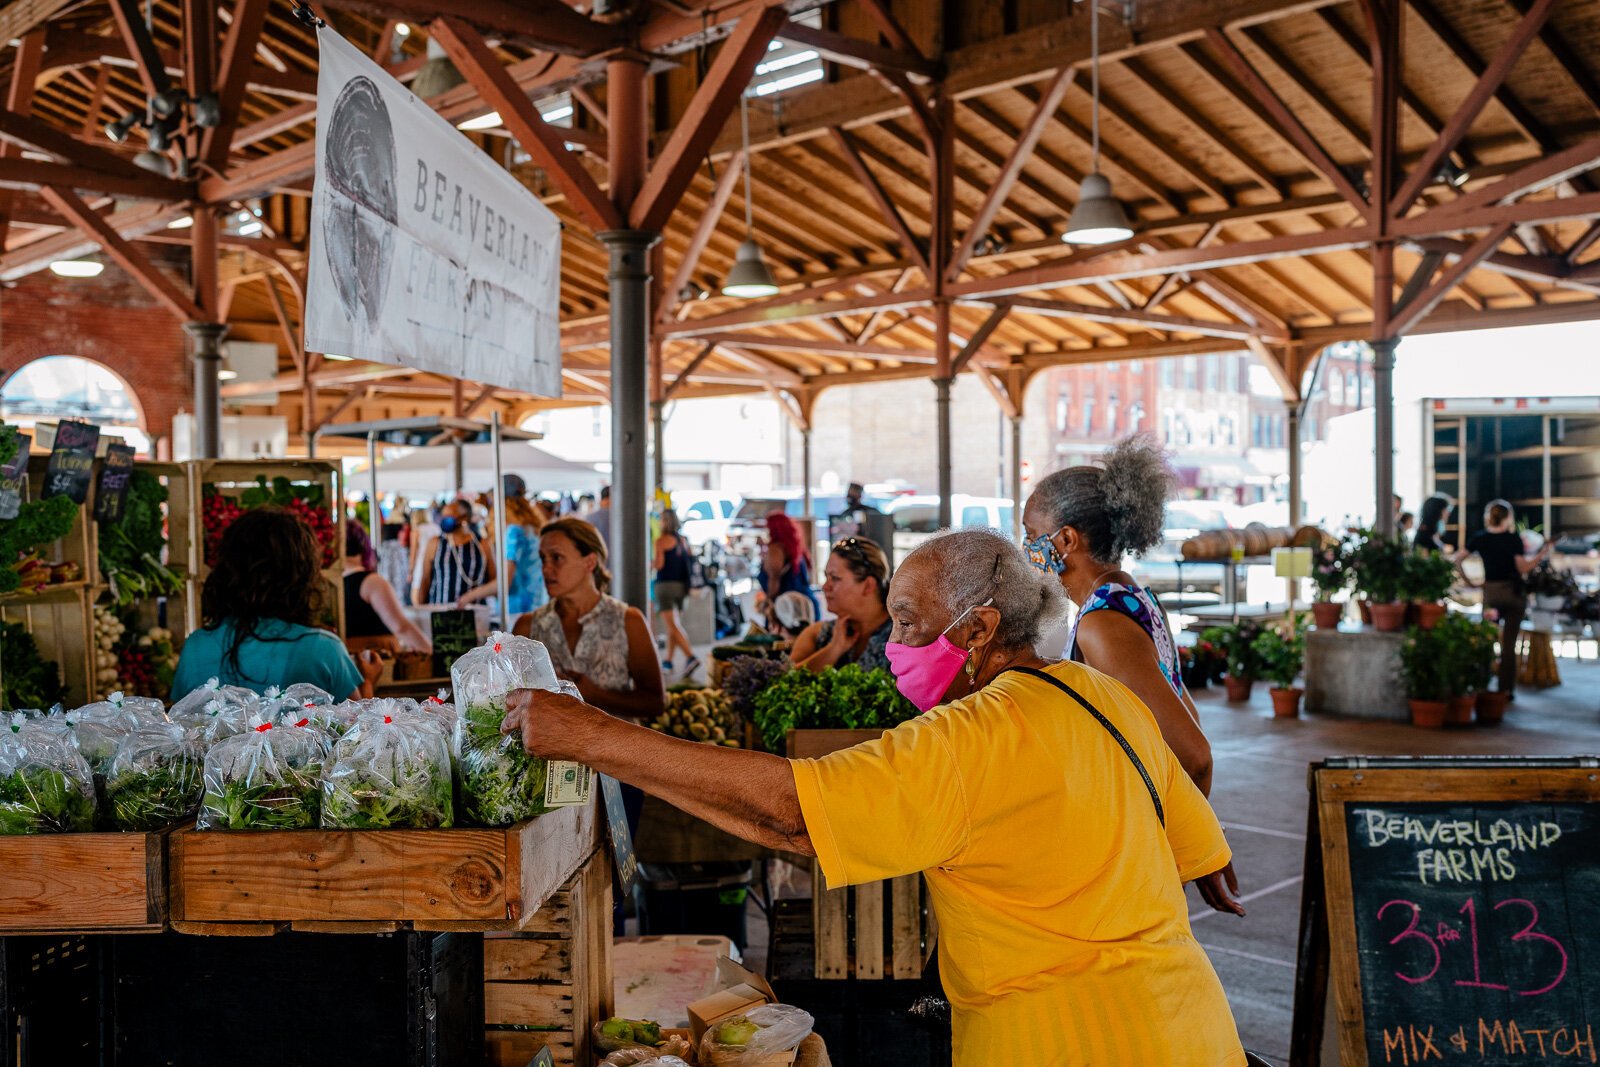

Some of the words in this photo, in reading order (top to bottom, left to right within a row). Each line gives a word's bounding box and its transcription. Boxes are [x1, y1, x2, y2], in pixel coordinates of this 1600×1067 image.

[1353, 808, 1562, 851] BEAVERLAND
[1416, 847, 1516, 885] FARMS
[1377, 899, 1441, 983] 3
[1455, 897, 1568, 996] 13
[1383, 1023, 1443, 1066] MIX
[1478, 1017, 1598, 1063] MATCH
